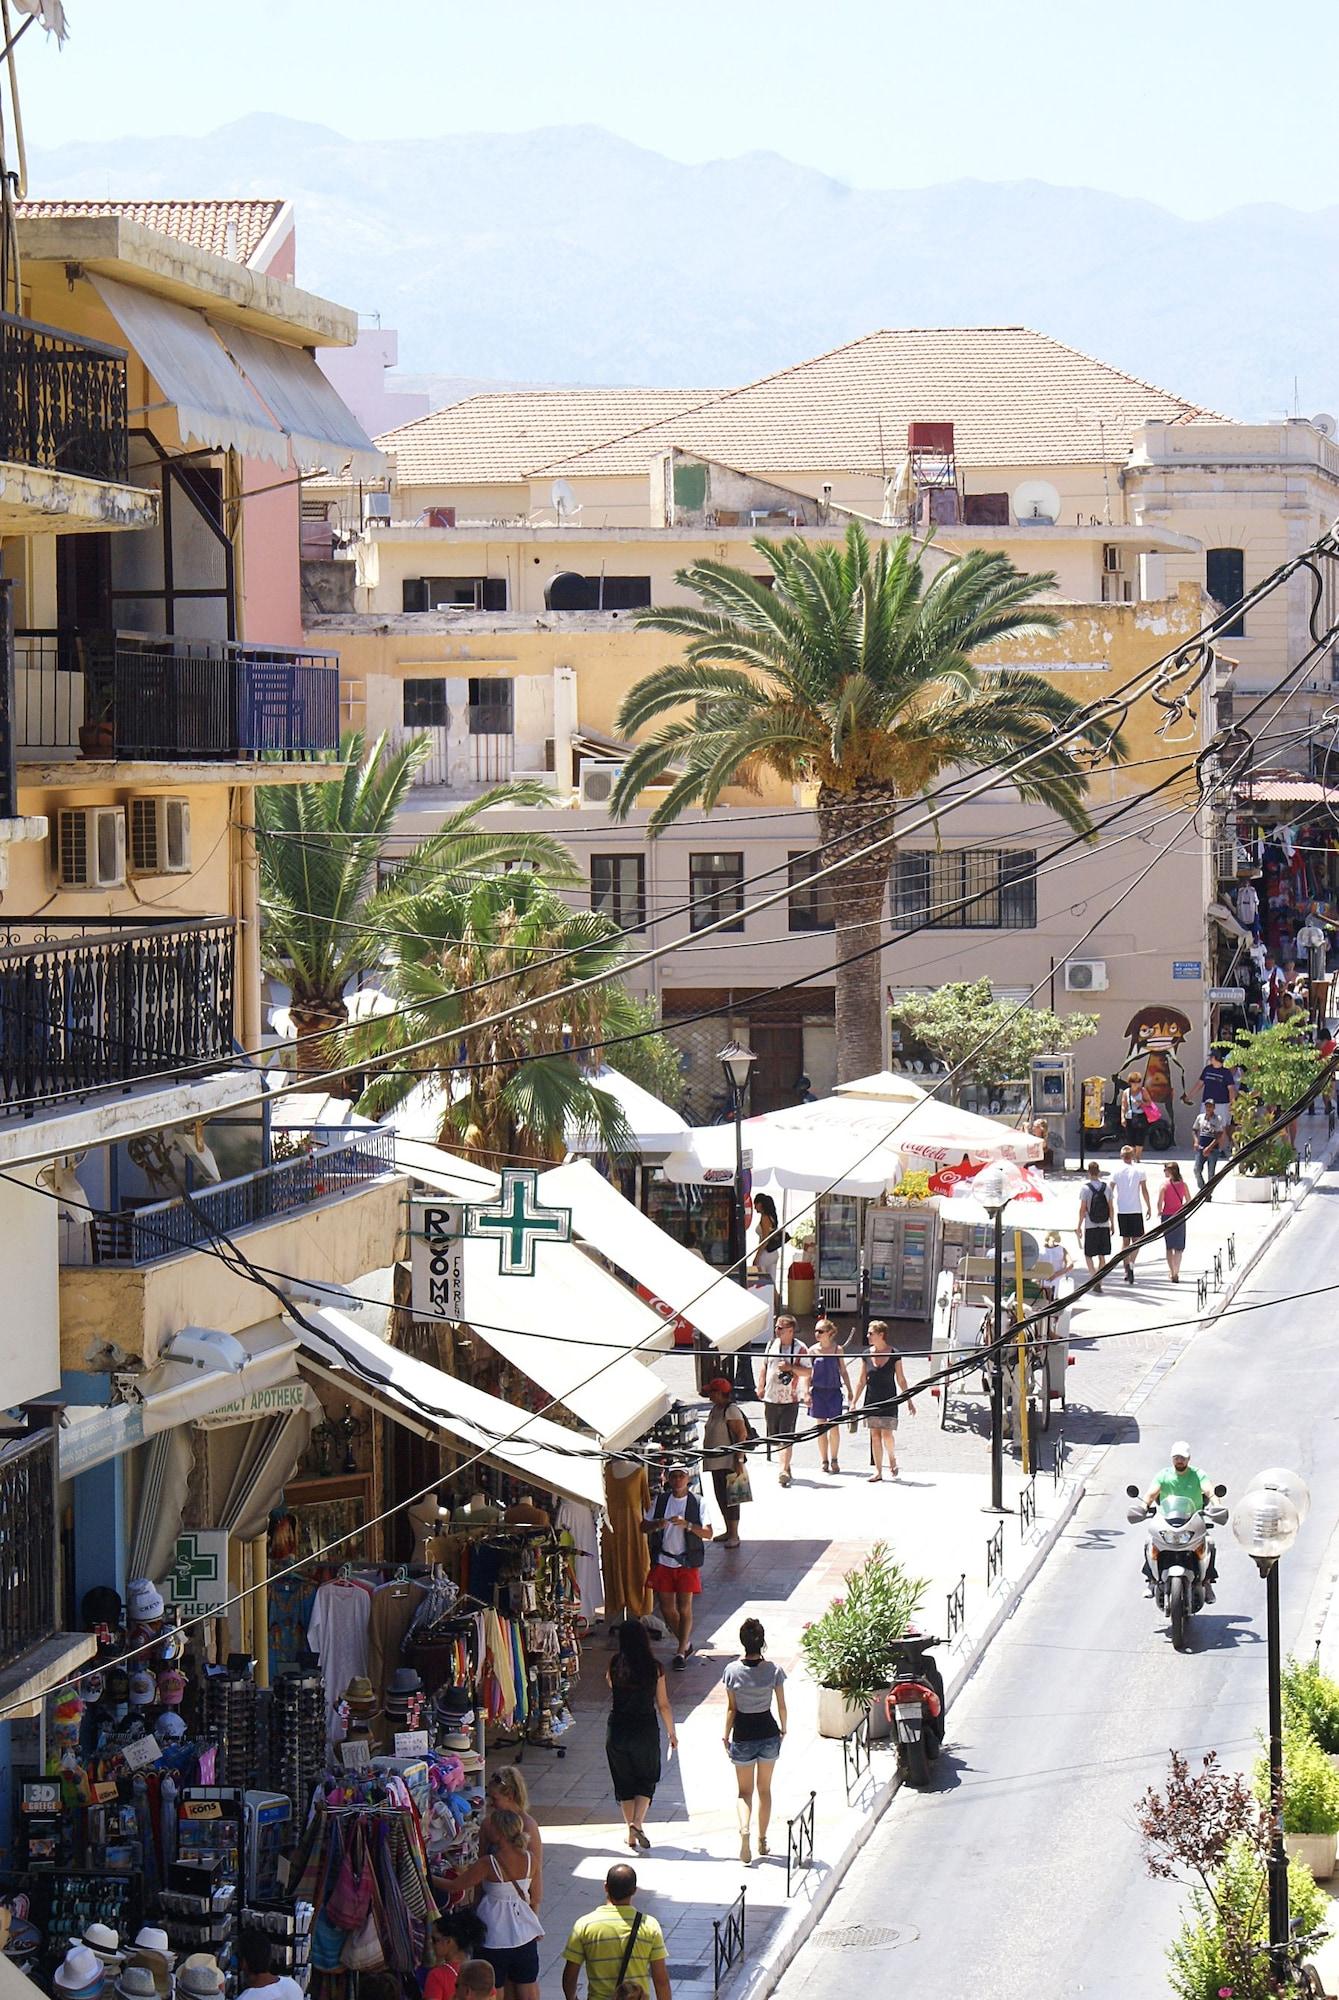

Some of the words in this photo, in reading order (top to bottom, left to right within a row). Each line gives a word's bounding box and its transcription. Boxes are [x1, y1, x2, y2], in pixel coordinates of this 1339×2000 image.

[424, 1208, 450, 1316] ROOMS
[453, 1256, 461, 1289] FOR
[250, 1387, 303, 1410] APOTHEKE
[30, 1784, 56, 1802] 3D
[28, 1801, 57, 1810] GREECE
[189, 1801, 217, 1815] icons
